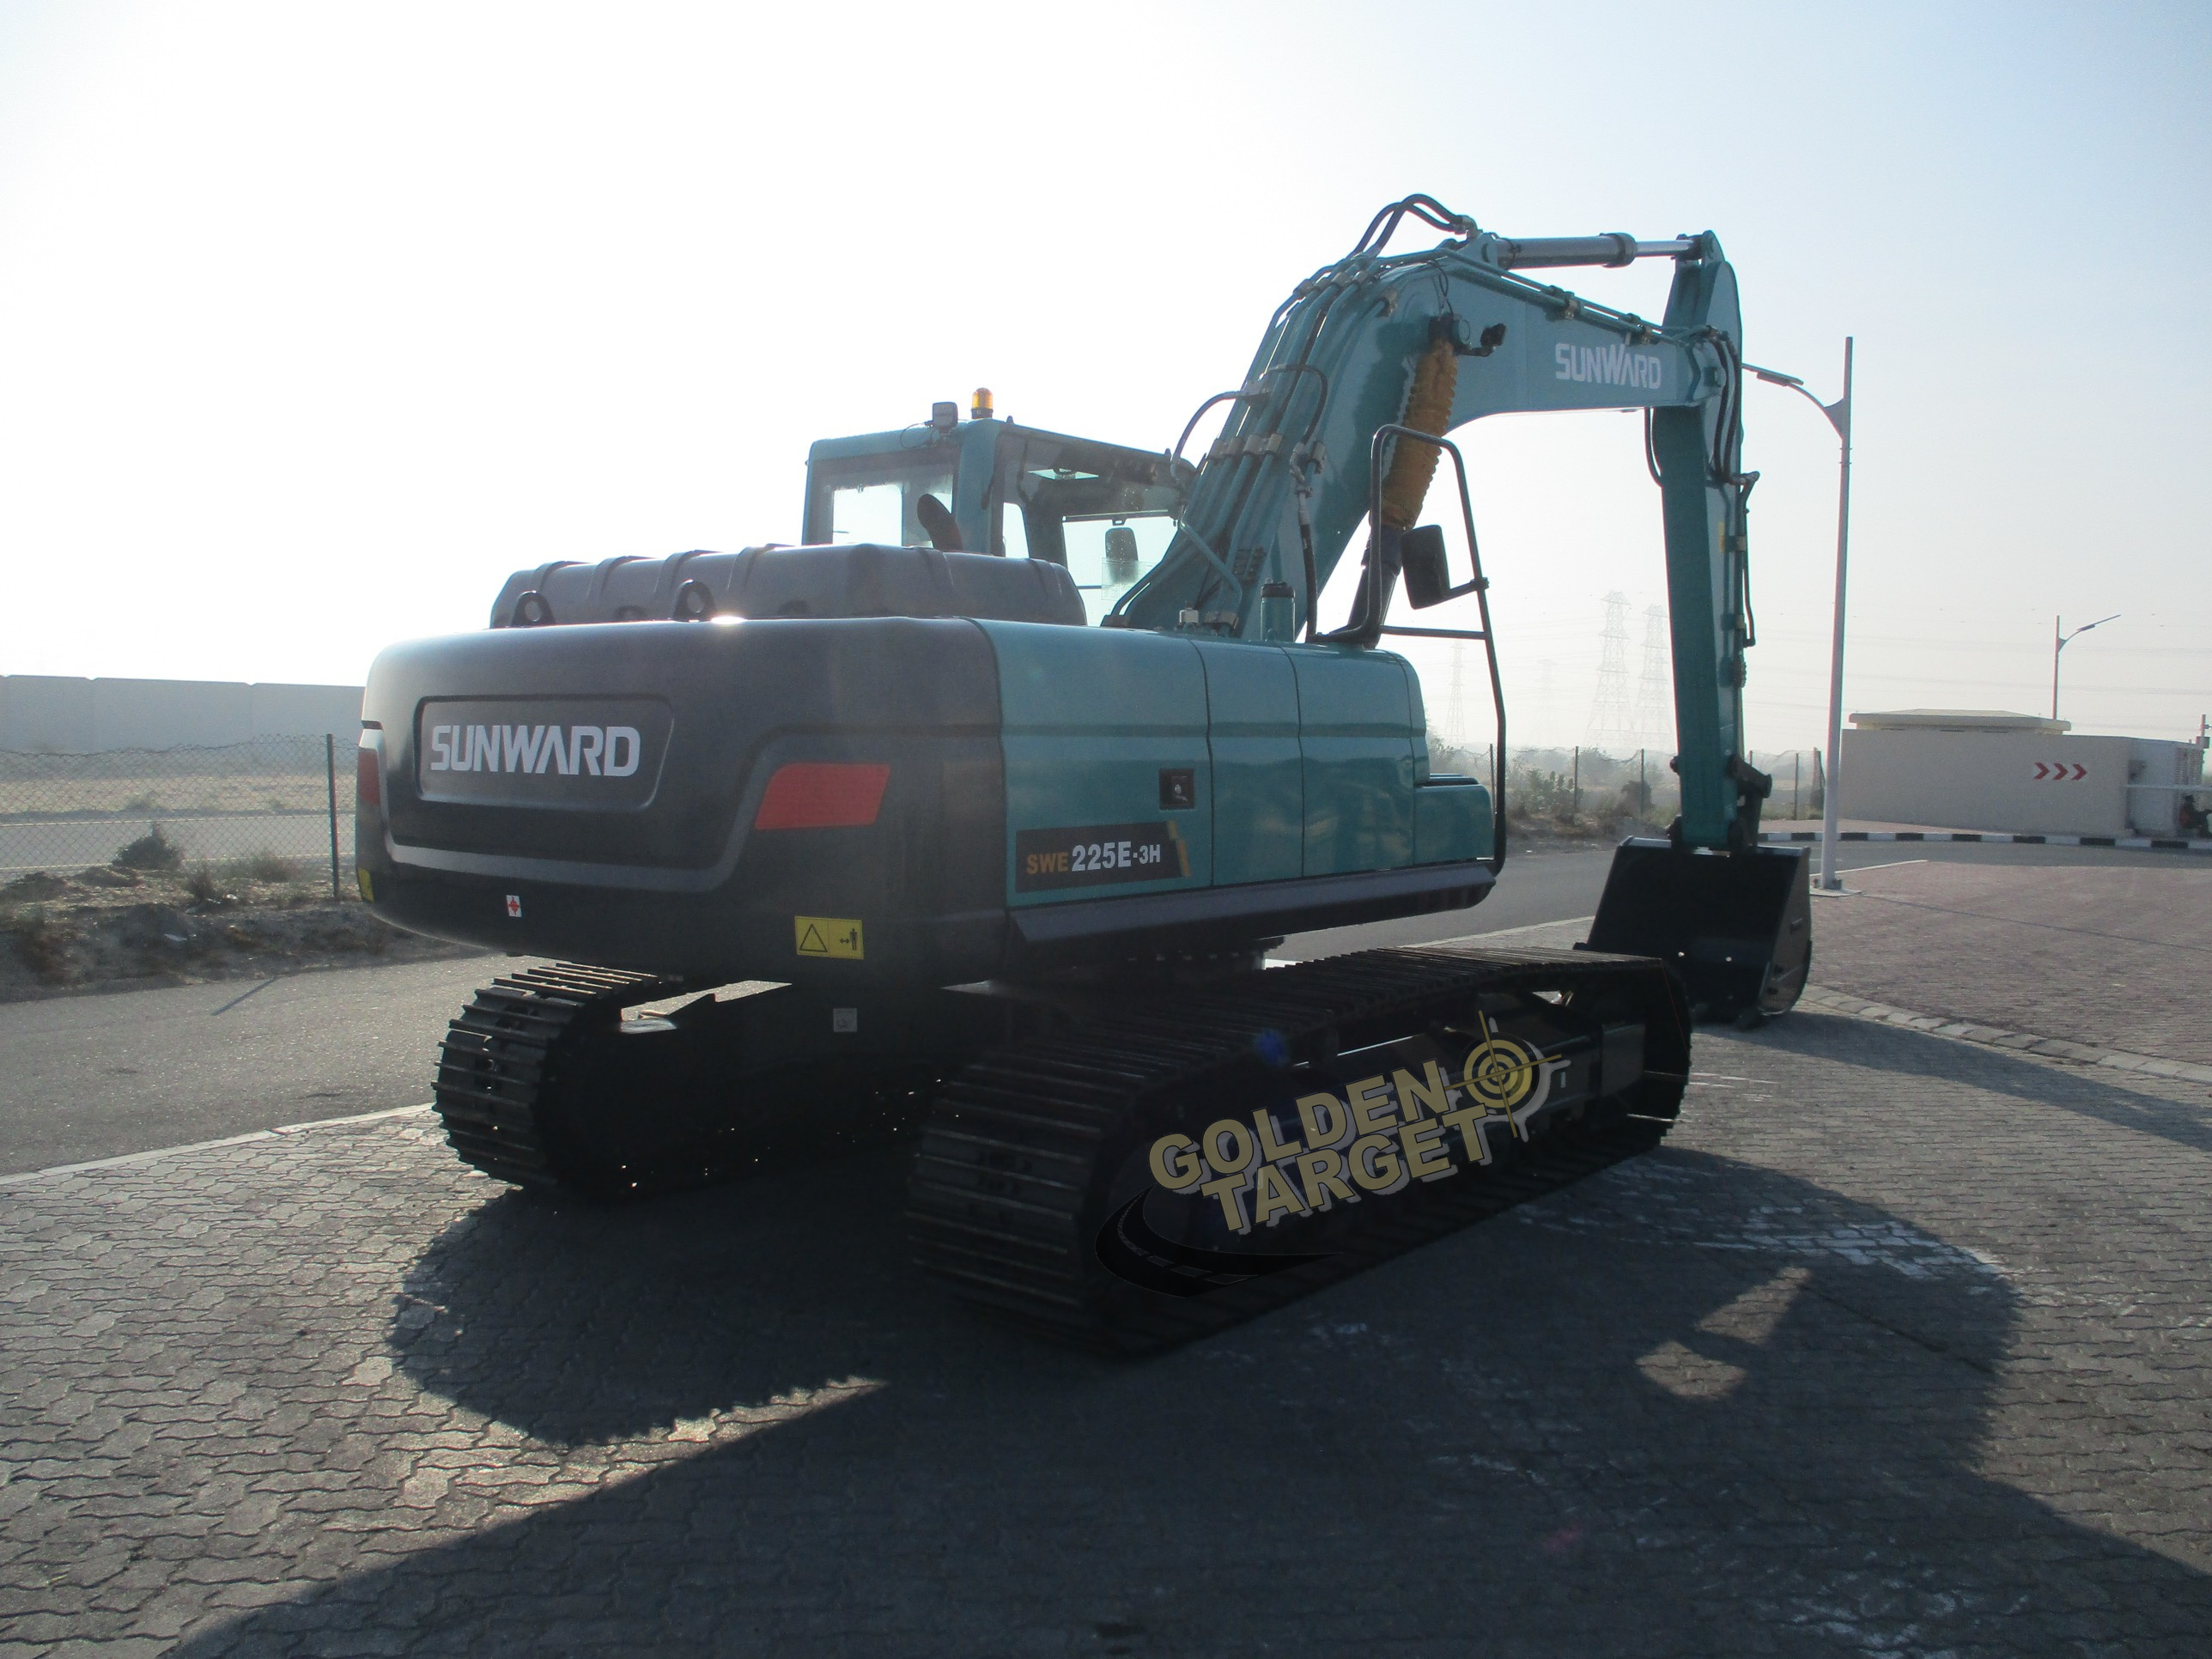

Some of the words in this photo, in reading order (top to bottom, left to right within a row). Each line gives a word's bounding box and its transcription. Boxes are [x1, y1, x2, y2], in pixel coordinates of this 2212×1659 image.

[1555, 343, 1662, 390] SUNWARD
[430, 725, 641, 776] SUNWARD
[1026, 852, 1069, 874] SWE
